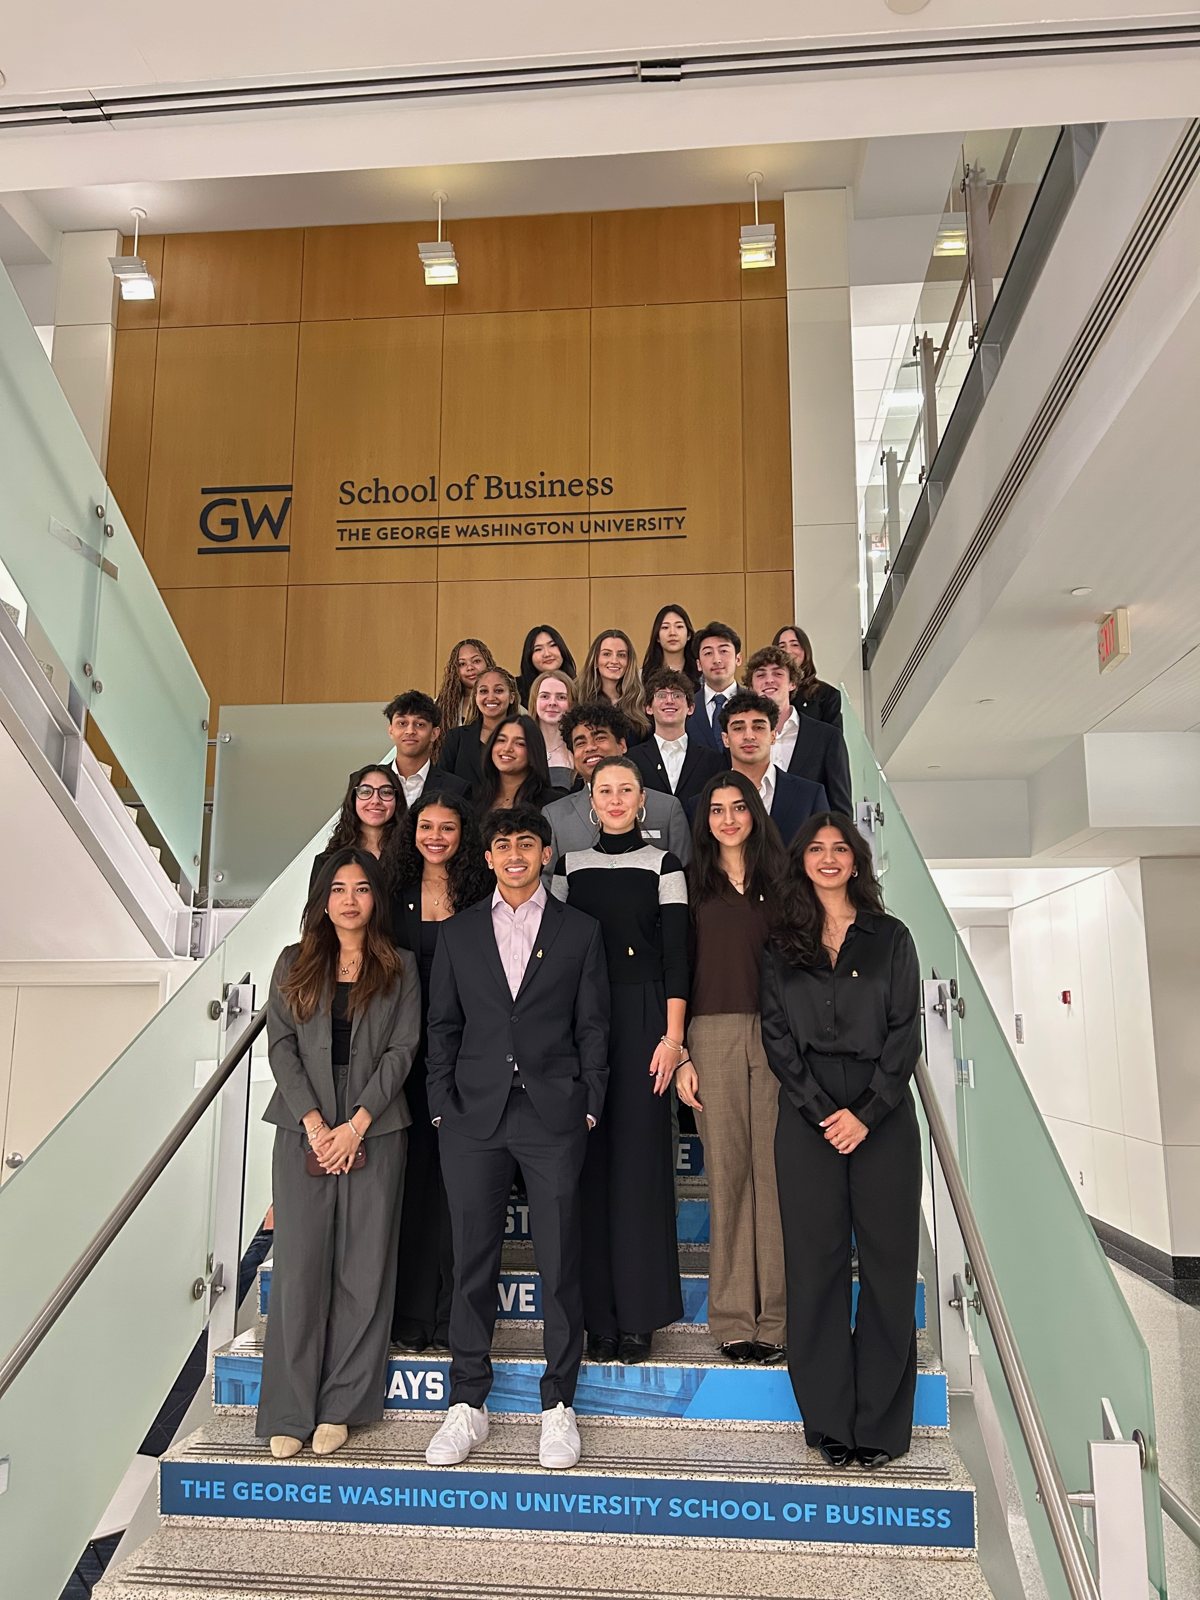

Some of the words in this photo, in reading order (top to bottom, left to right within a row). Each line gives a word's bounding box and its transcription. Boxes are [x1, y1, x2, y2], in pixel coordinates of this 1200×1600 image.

[339, 475, 438, 505] School
[446, 473, 480, 501] of
[484, 471, 614, 500] Business
[199, 496, 292, 543] GW
[336, 527, 371, 542] THE
[376, 525, 451, 541] GEORGE
[455, 521, 574, 538] WASHINGTON
[580, 516, 686, 534] UNIVERSITY
[497, 1282, 536, 1312] VE
[384, 1370, 444, 1401] AYS
[180, 1480, 226, 1500] THE
[232, 1481, 332, 1504] GEORGE
[337, 1485, 508, 1511] WASHINGTON
[516, 1492, 663, 1517] UNIVERSITY
[668, 1497, 777, 1521] SCHOOL
[782, 1502, 819, 1524] OF
[826, 1504, 952, 1529] BUSINESS
